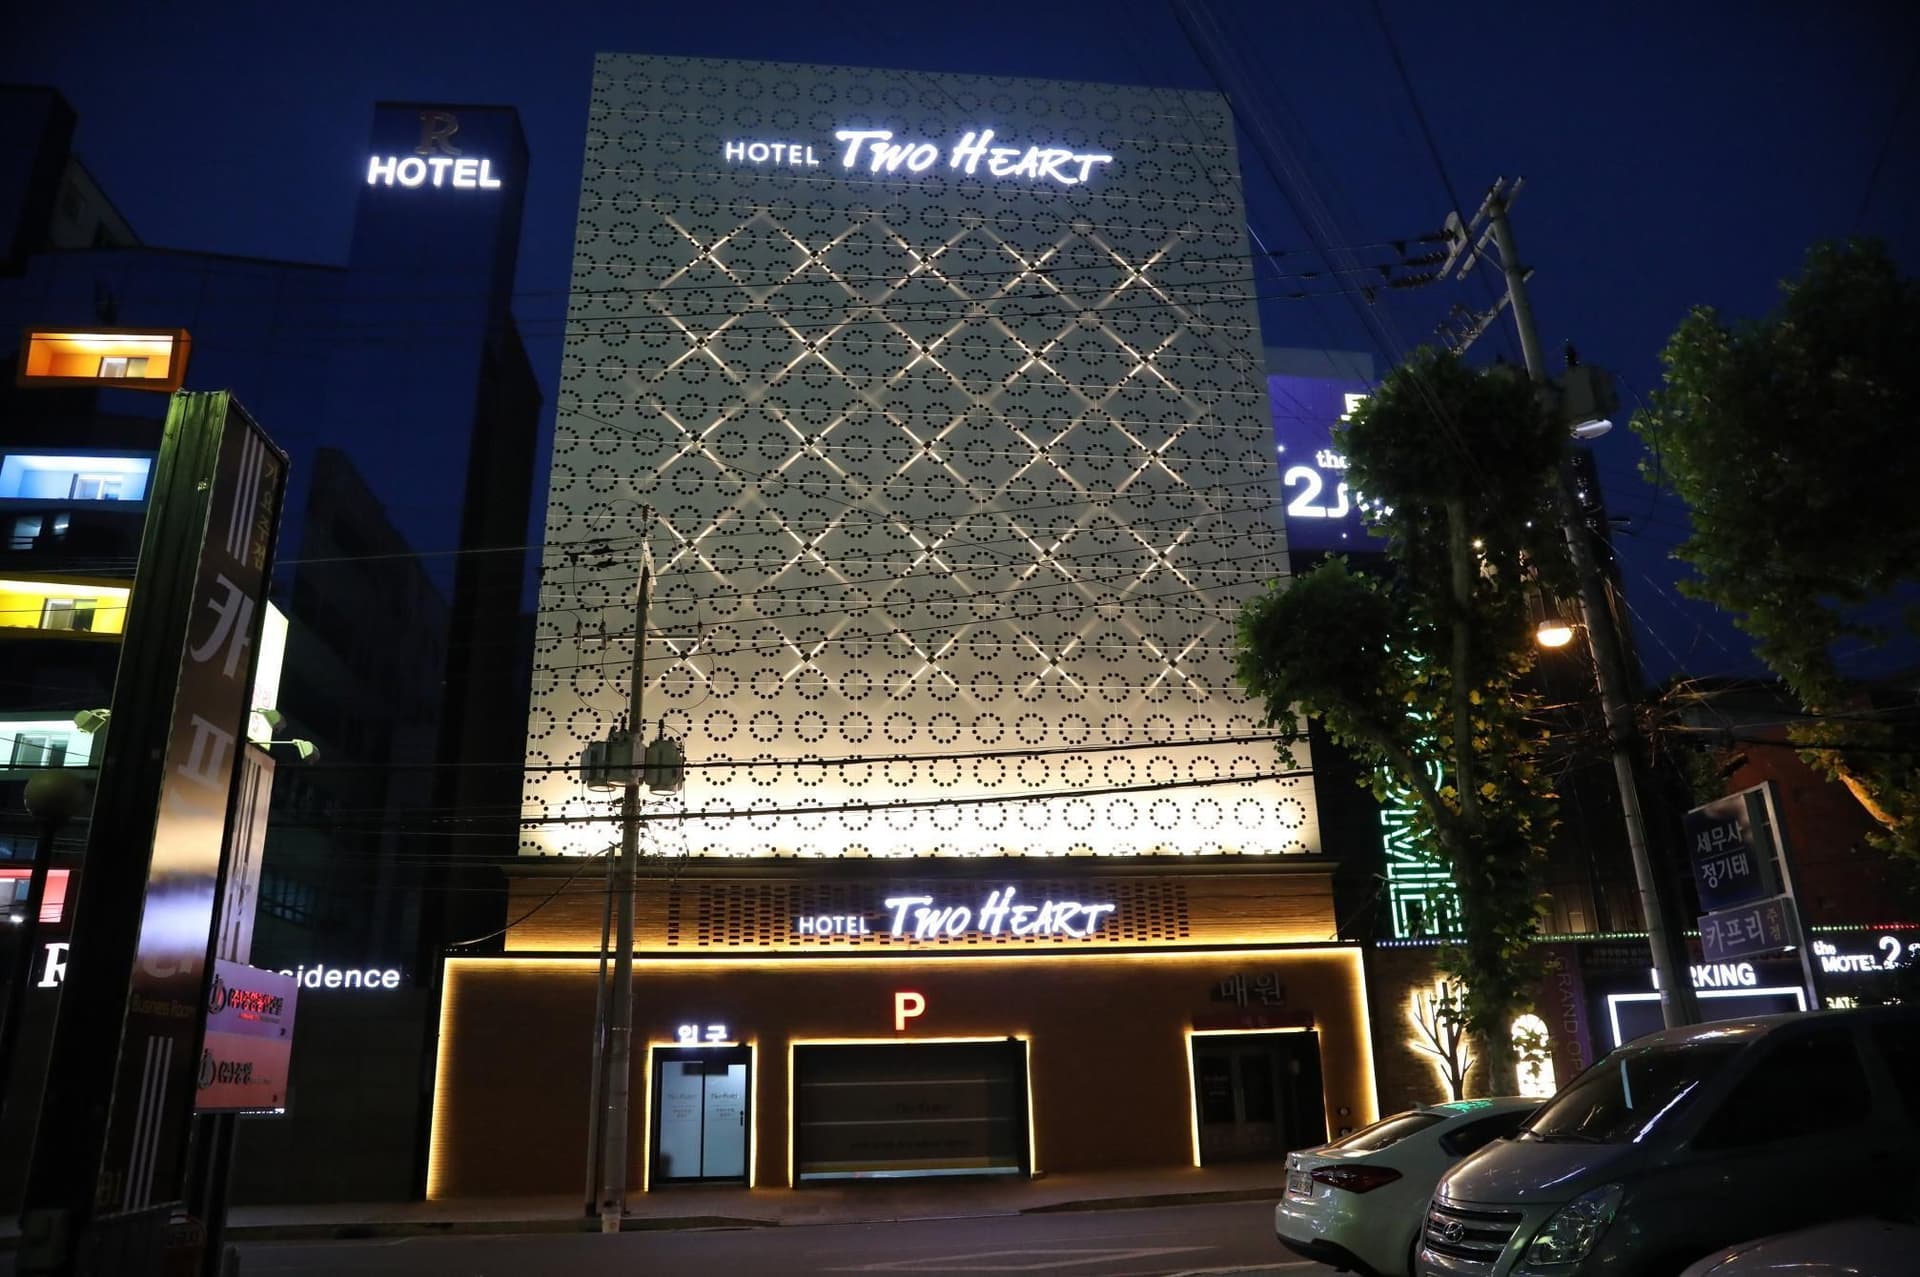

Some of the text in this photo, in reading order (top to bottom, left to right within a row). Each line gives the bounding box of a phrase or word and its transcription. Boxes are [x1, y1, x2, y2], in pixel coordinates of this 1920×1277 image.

[414, 111, 463, 155] R
[726, 142, 820, 166] HOTEL
[366, 155, 502, 189] HOTEL
[1696, 821, 1744, 854] 세무사
[1701, 854, 1750, 889] 정기태
[799, 915, 871, 936] HOTEL
[1705, 910, 1766, 953] 카프리
[1813, 941, 1837, 956] the
[1220, 972, 1286, 1008] 매원
[895, 992, 925, 1031] P
[677, 1024, 728, 1045] 입구
